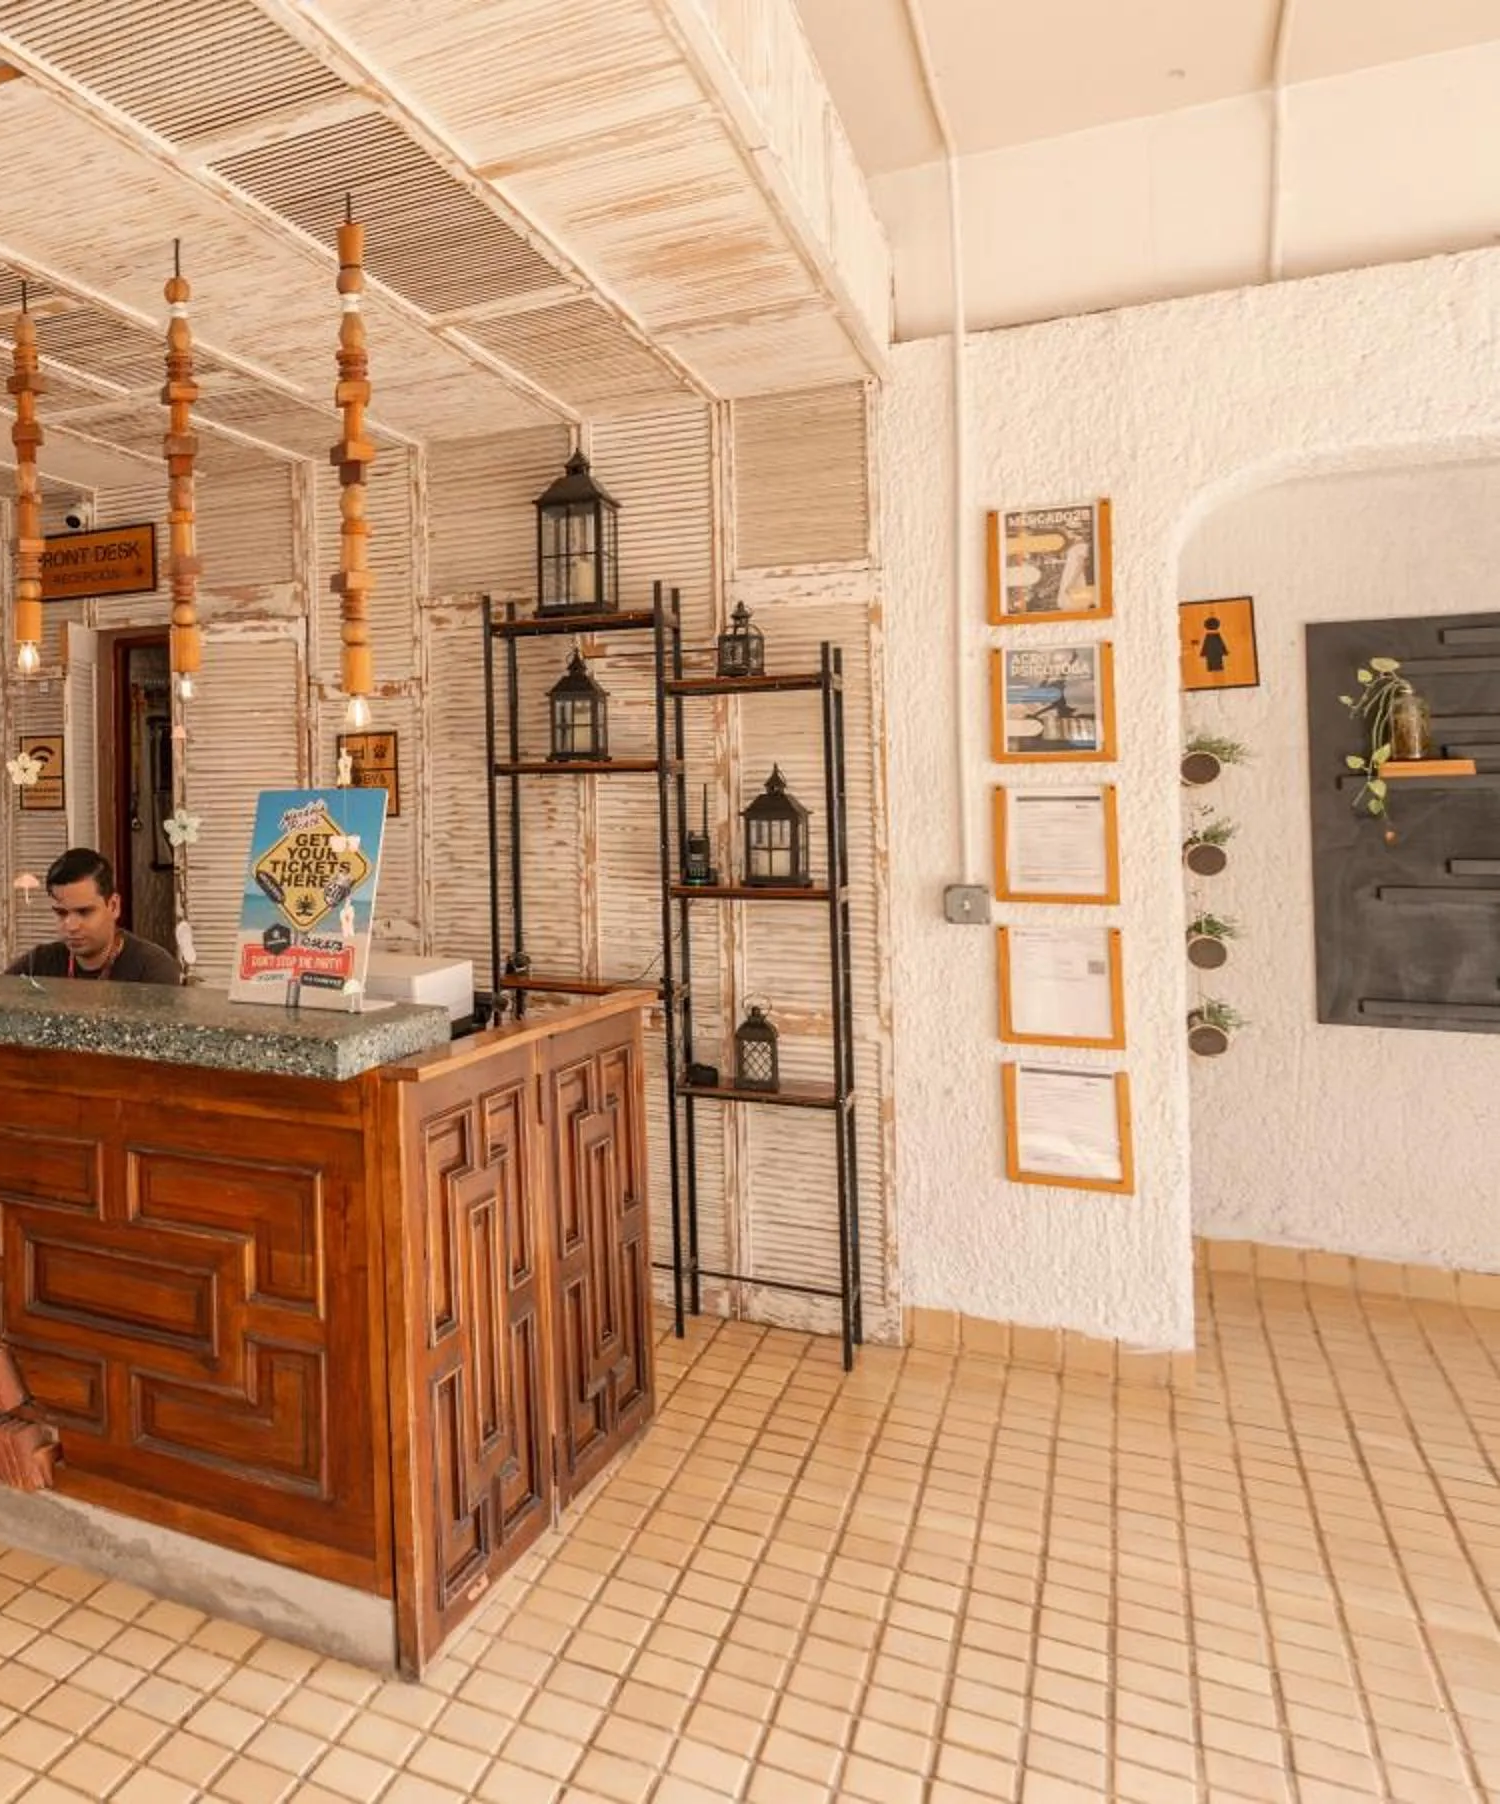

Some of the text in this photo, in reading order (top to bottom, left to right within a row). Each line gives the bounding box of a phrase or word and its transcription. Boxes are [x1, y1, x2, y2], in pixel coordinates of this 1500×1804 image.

[95, 540, 139, 562] DESK
[296, 833, 334, 847] GET
[287, 847, 338, 861] YOUR
[269, 860, 351, 874] TICKETS
